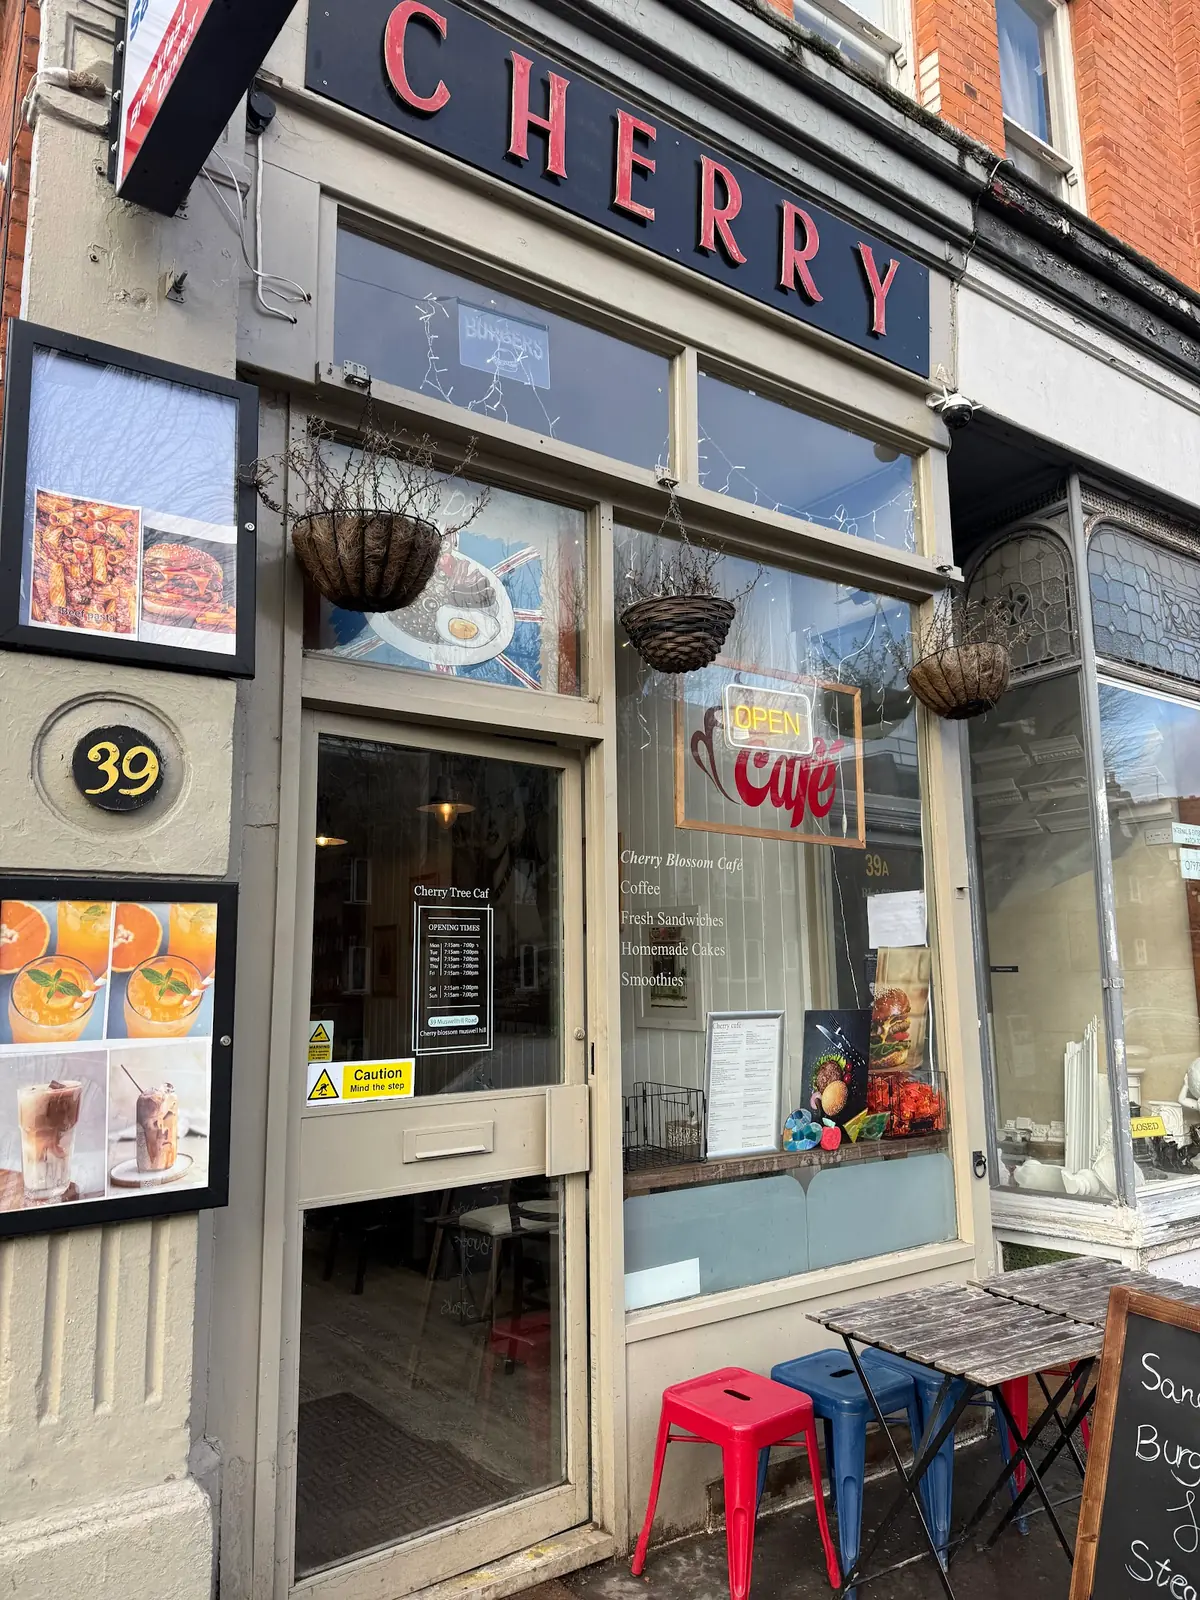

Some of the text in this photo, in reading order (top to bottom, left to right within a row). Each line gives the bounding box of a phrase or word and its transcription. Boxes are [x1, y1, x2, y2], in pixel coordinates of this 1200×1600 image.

[384, 0, 900, 337] CHERRY
[60, 606, 117, 622] Beef pasta
[734, 704, 801, 736] OPEN
[84, 741, 160, 797] 39
[734, 737, 845, 829] Café
[620, 850, 743, 873] Cherry Blossom Café
[865, 853, 889, 877] 39A
[414, 885, 490, 899] Cherry Tree Caf
[620, 880, 661, 895] Coffee
[620, 910, 724, 927] Fresh Sandwiches
[460, 924, 480, 932] TIMES
[620, 941, 726, 956] Homemade Cakes
[621, 972, 684, 987] Smoothies
[712, 1022, 730, 1031] Cherry
[354, 1068, 402, 1081] Caution
[350, 1082, 405, 1093] Mind the step
[1131, 1122, 1160, 1132] LOSED
